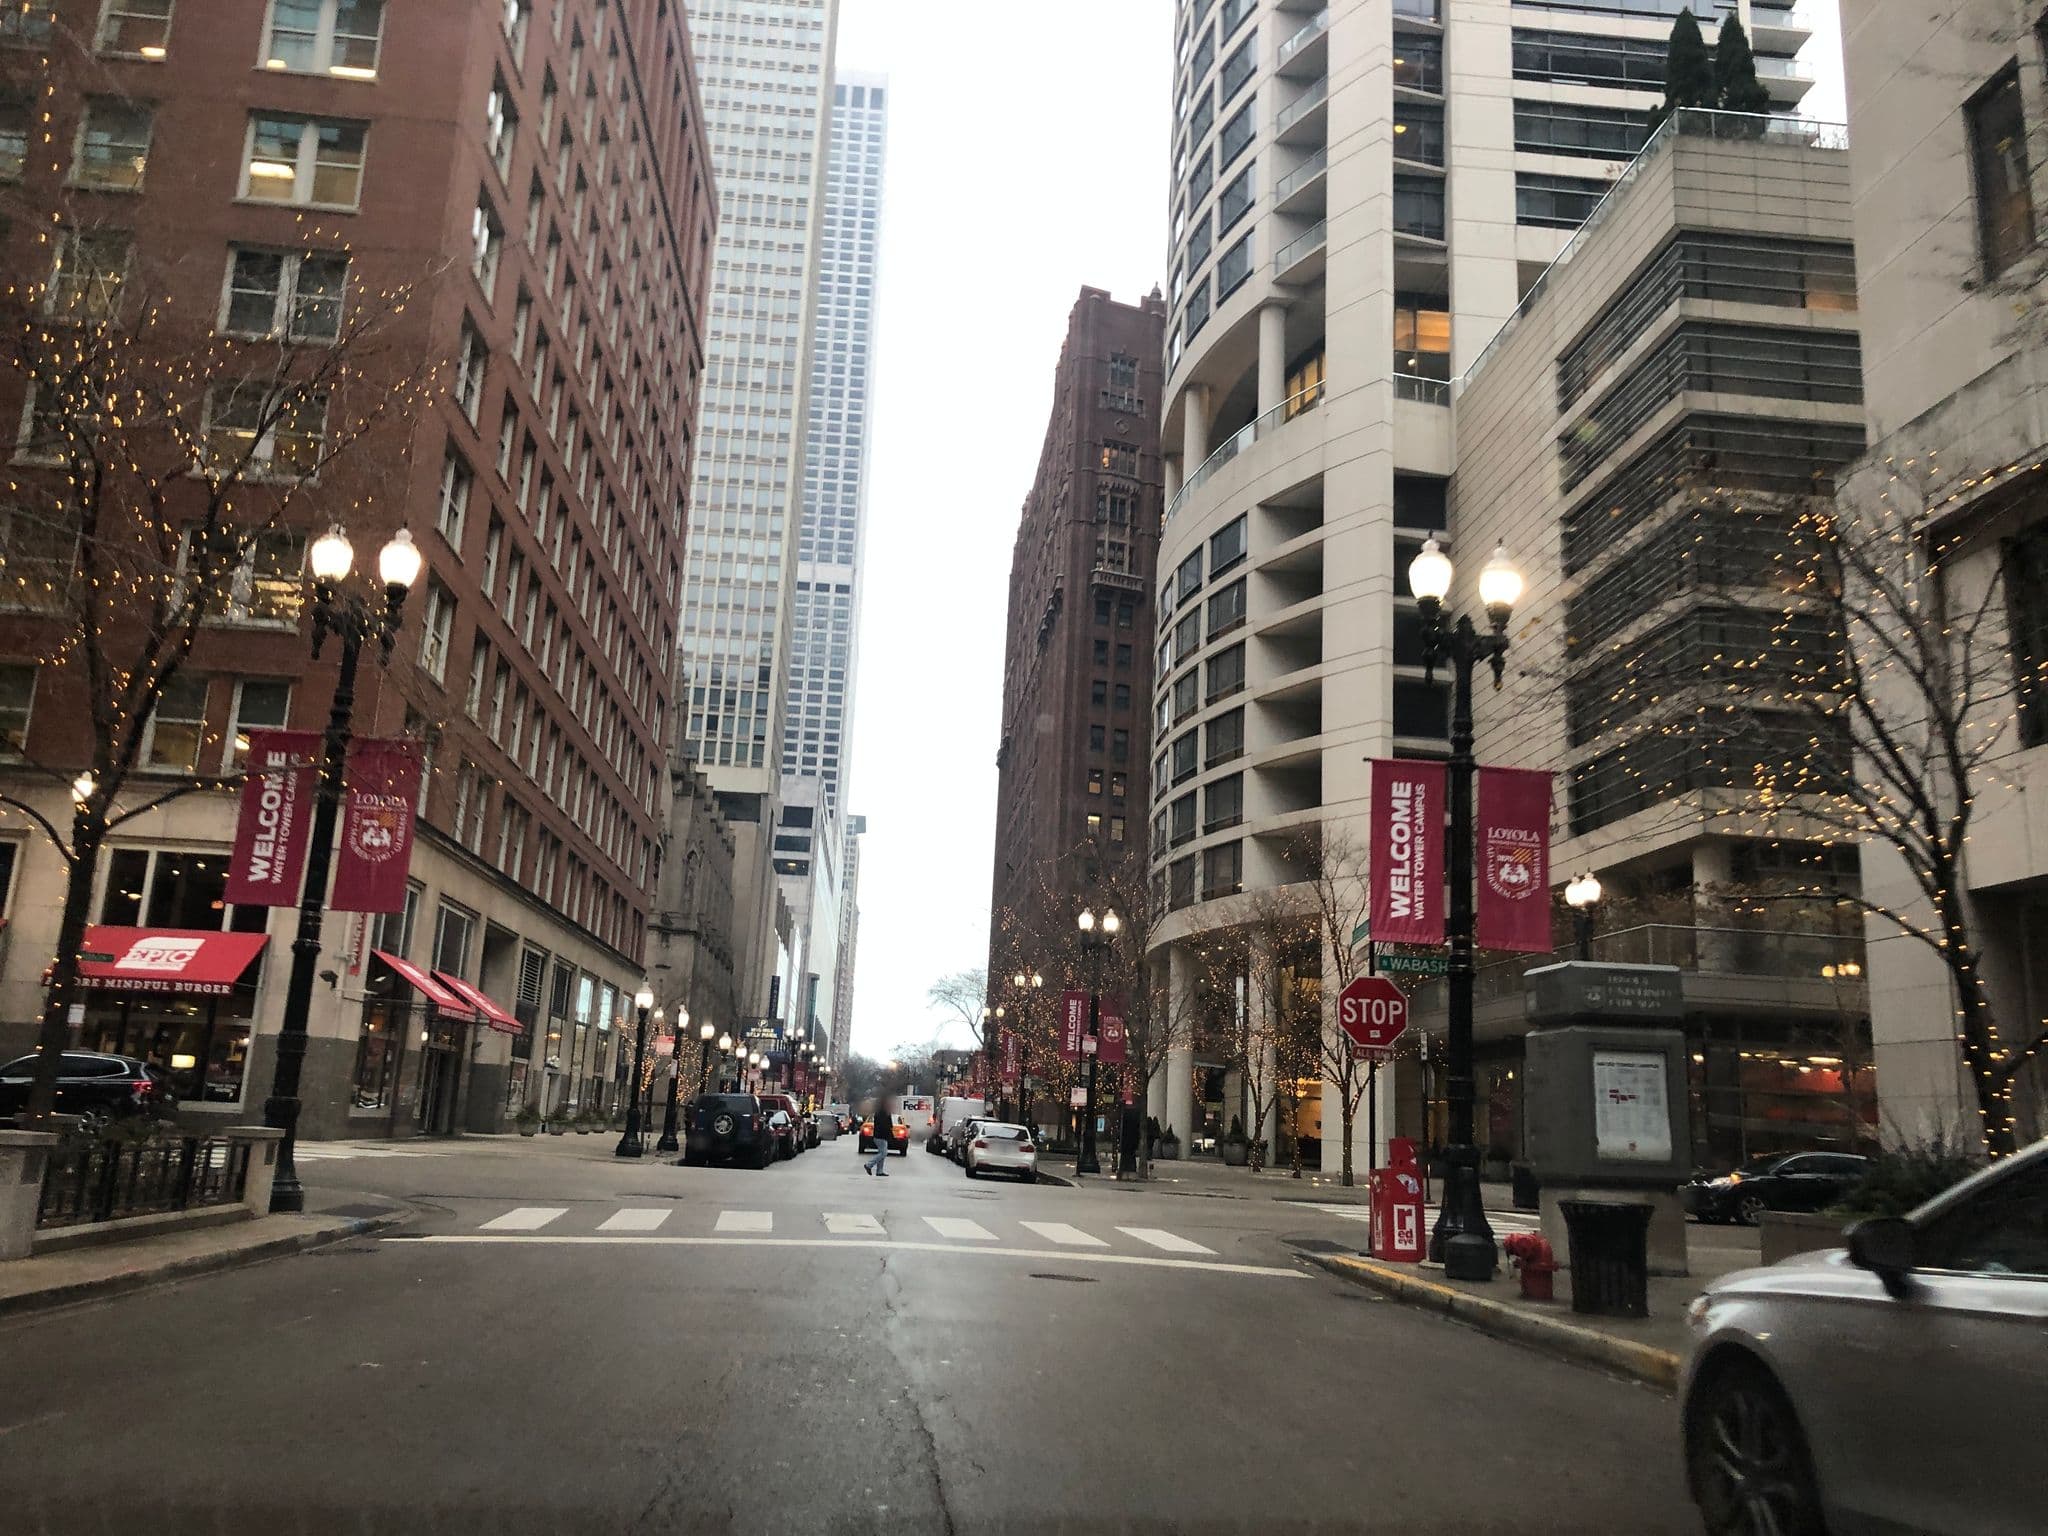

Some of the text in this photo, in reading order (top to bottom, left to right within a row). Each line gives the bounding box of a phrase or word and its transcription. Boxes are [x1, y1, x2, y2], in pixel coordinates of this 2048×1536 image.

[247, 751, 286, 882] WELCOME
[271, 845, 287, 884] WATER
[279, 800, 294, 843] TOWER
[1487, 827, 1540, 842] LOYOLA
[1390, 781, 1412, 918] WELCOME
[1414, 783, 1426, 920] WATER TOWER CAMPUS
[122, 949, 197, 963] EPIC
[1390, 957, 1449, 972] WABASH
[104, 979, 170, 990] MINDFUL
[174, 982, 231, 994] BURGER
[1066, 999, 1078, 1051] WELCOME
[1343, 997, 1403, 1025] STOP
[903, 1100, 932, 1110] FedEx
